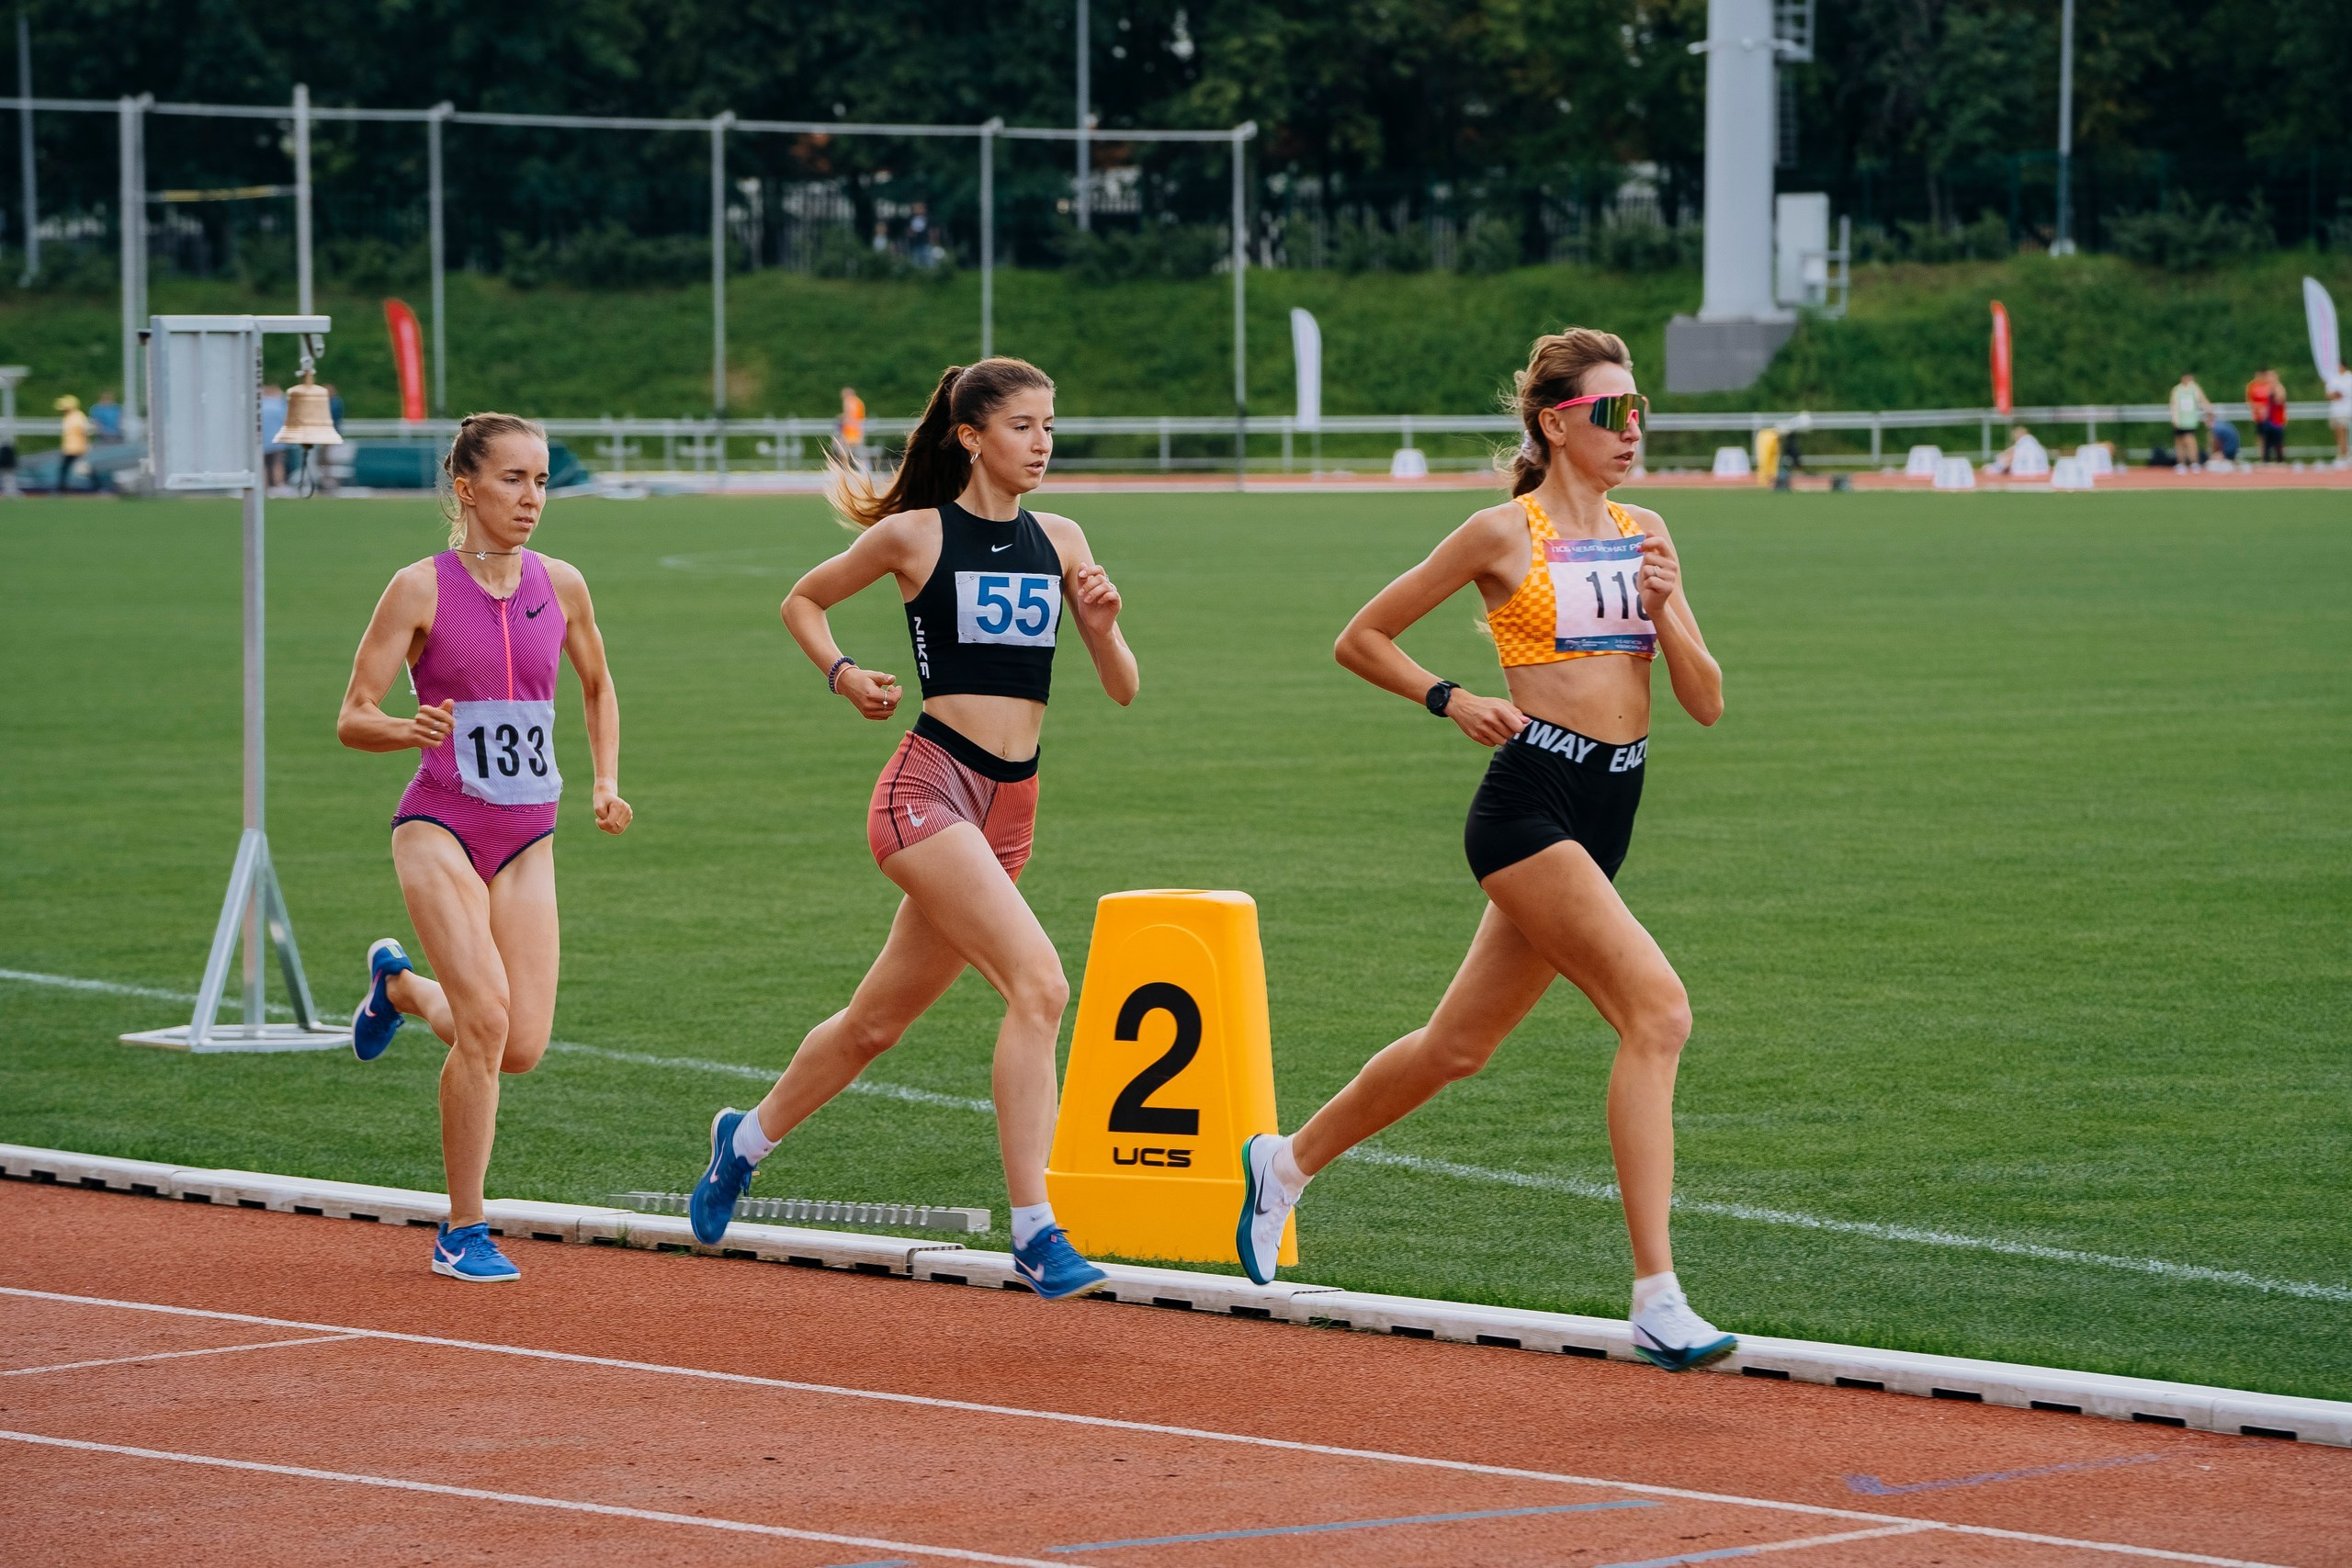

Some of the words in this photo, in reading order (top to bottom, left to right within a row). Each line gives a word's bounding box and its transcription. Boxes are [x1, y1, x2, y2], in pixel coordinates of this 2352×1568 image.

[976, 575, 1050, 637] 55
[467, 723, 548, 779] 133
[1107, 981, 1203, 1136] 2
[1113, 1146, 1194, 1168] UCS
